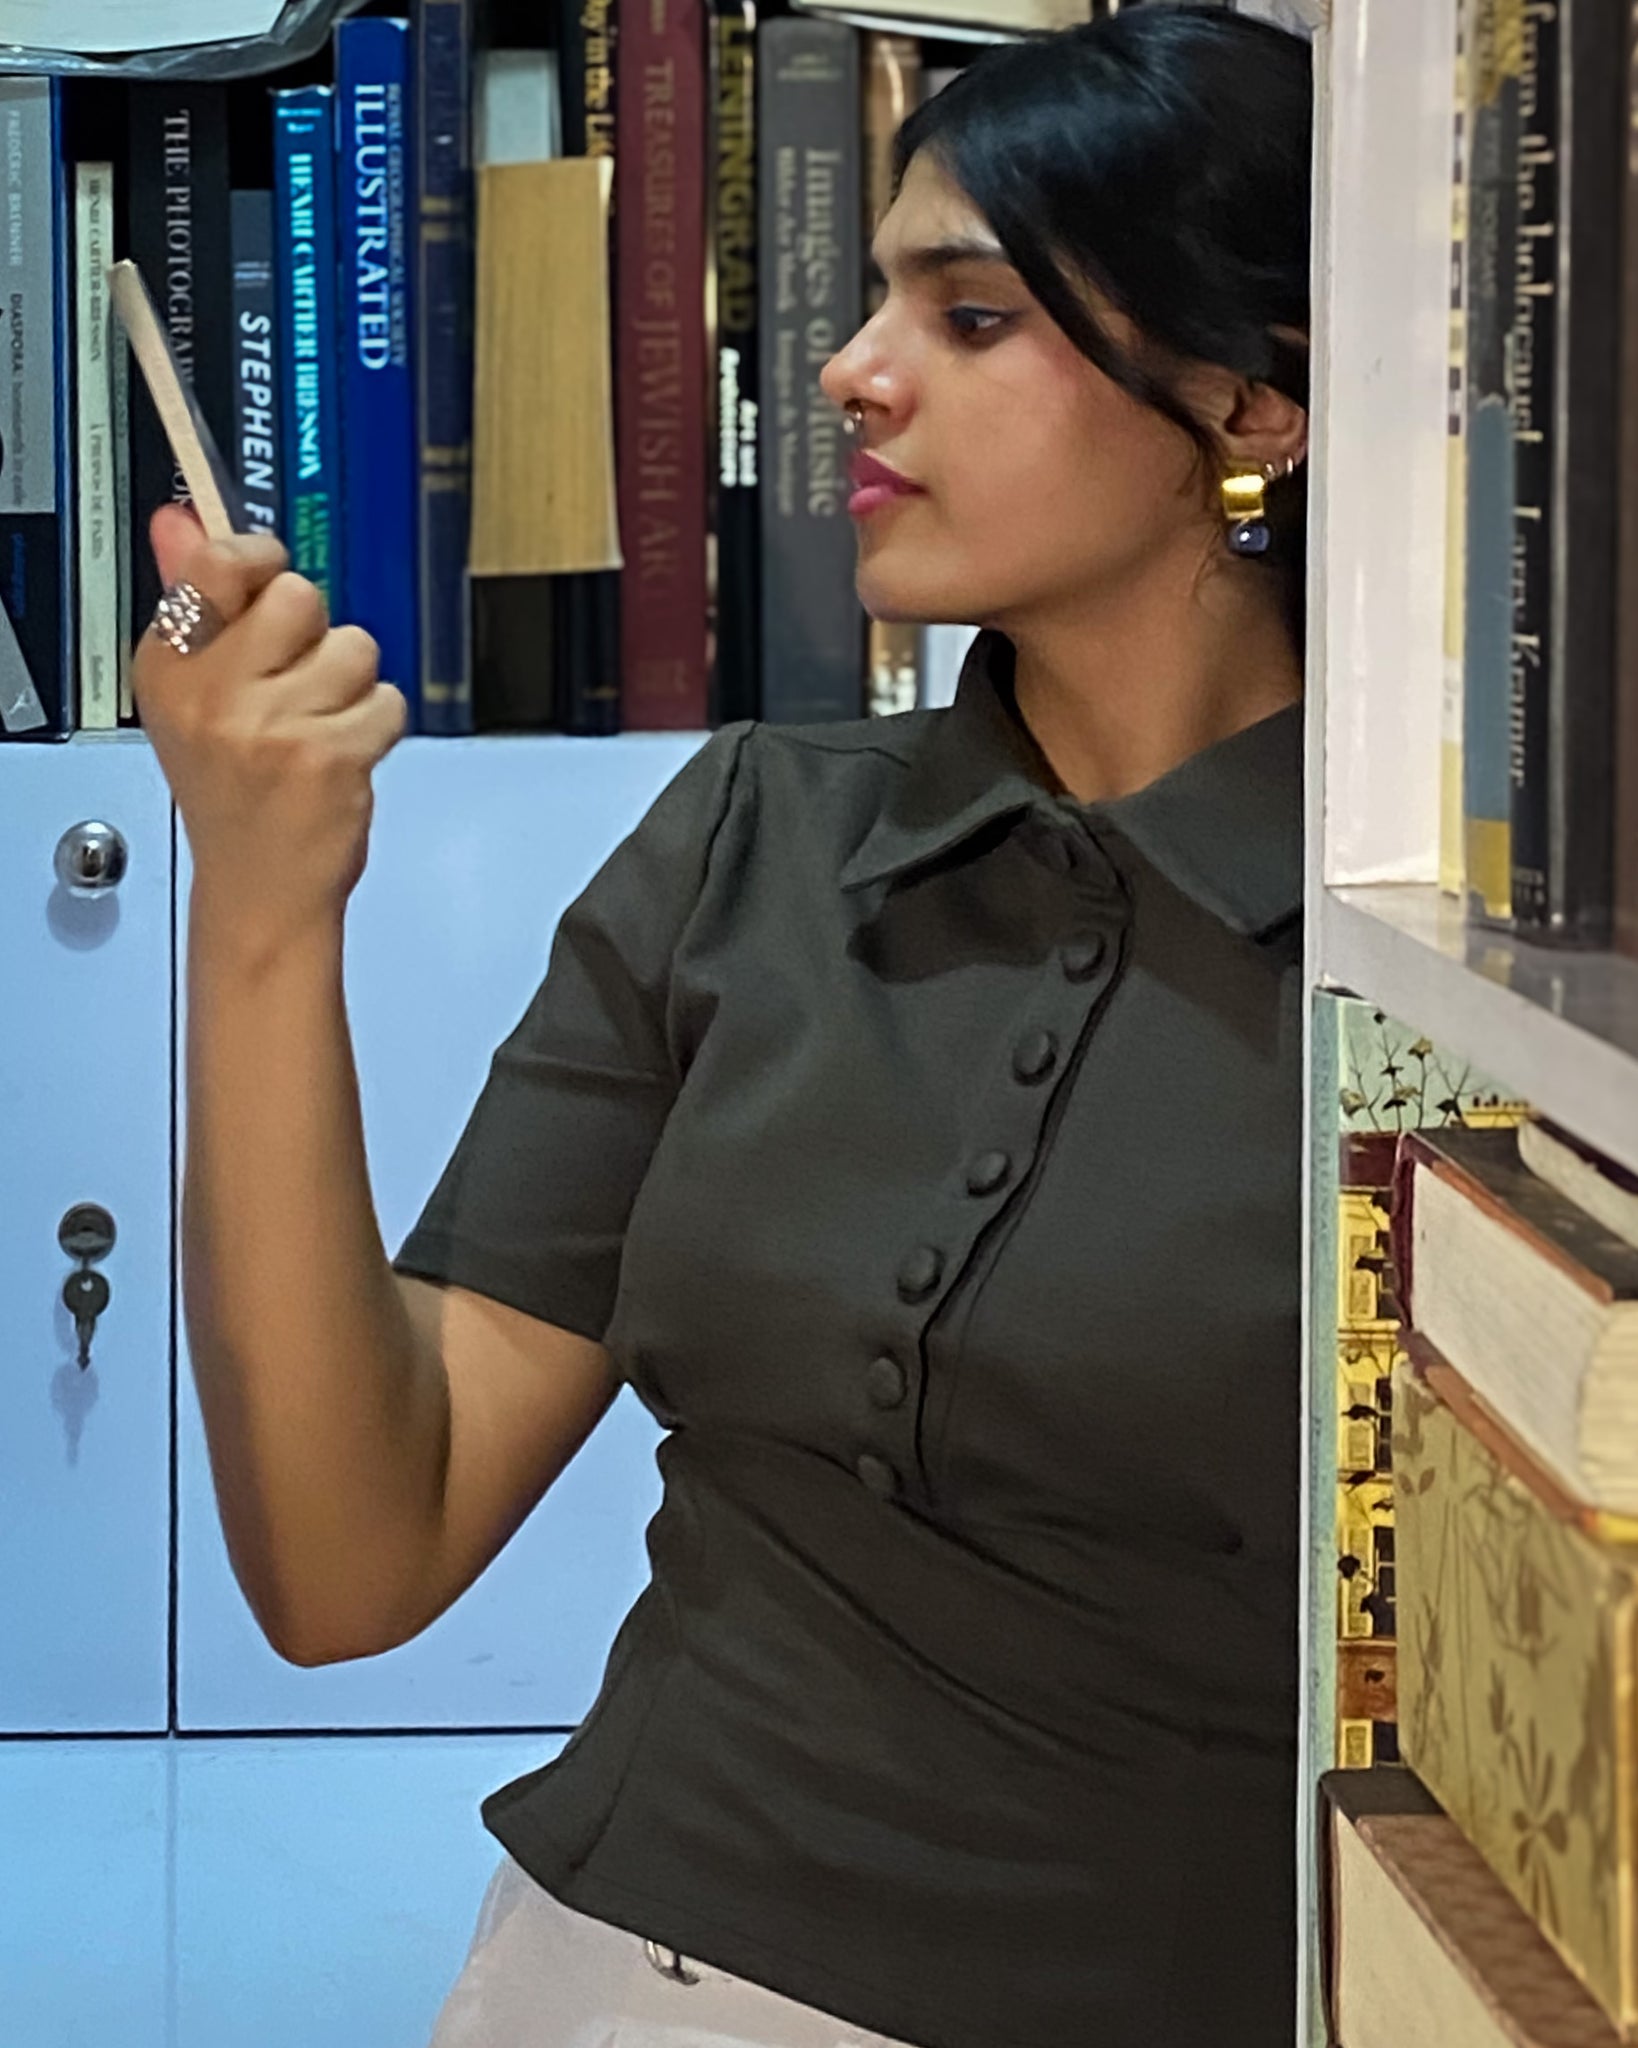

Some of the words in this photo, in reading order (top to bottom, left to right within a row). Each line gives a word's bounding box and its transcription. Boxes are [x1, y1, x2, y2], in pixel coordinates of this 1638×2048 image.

[162, 109, 192, 177] THE
[584, 66, 614, 110] the
[289, 153, 314, 239] HENRI
[644, 55, 677, 254] TREASURES
[1516, 133, 1555, 211] the
[354, 83, 391, 370] ILLUSTRATED
[644, 258, 677, 310] OF
[797, 147, 842, 305] Images
[291, 241, 318, 358] CARTIER
[1506, 222, 1555, 442] holocaust
[239, 310, 276, 490] STEPHEN
[296, 362, 322, 480] BRESSON
[632, 317, 683, 503] JEWISH
